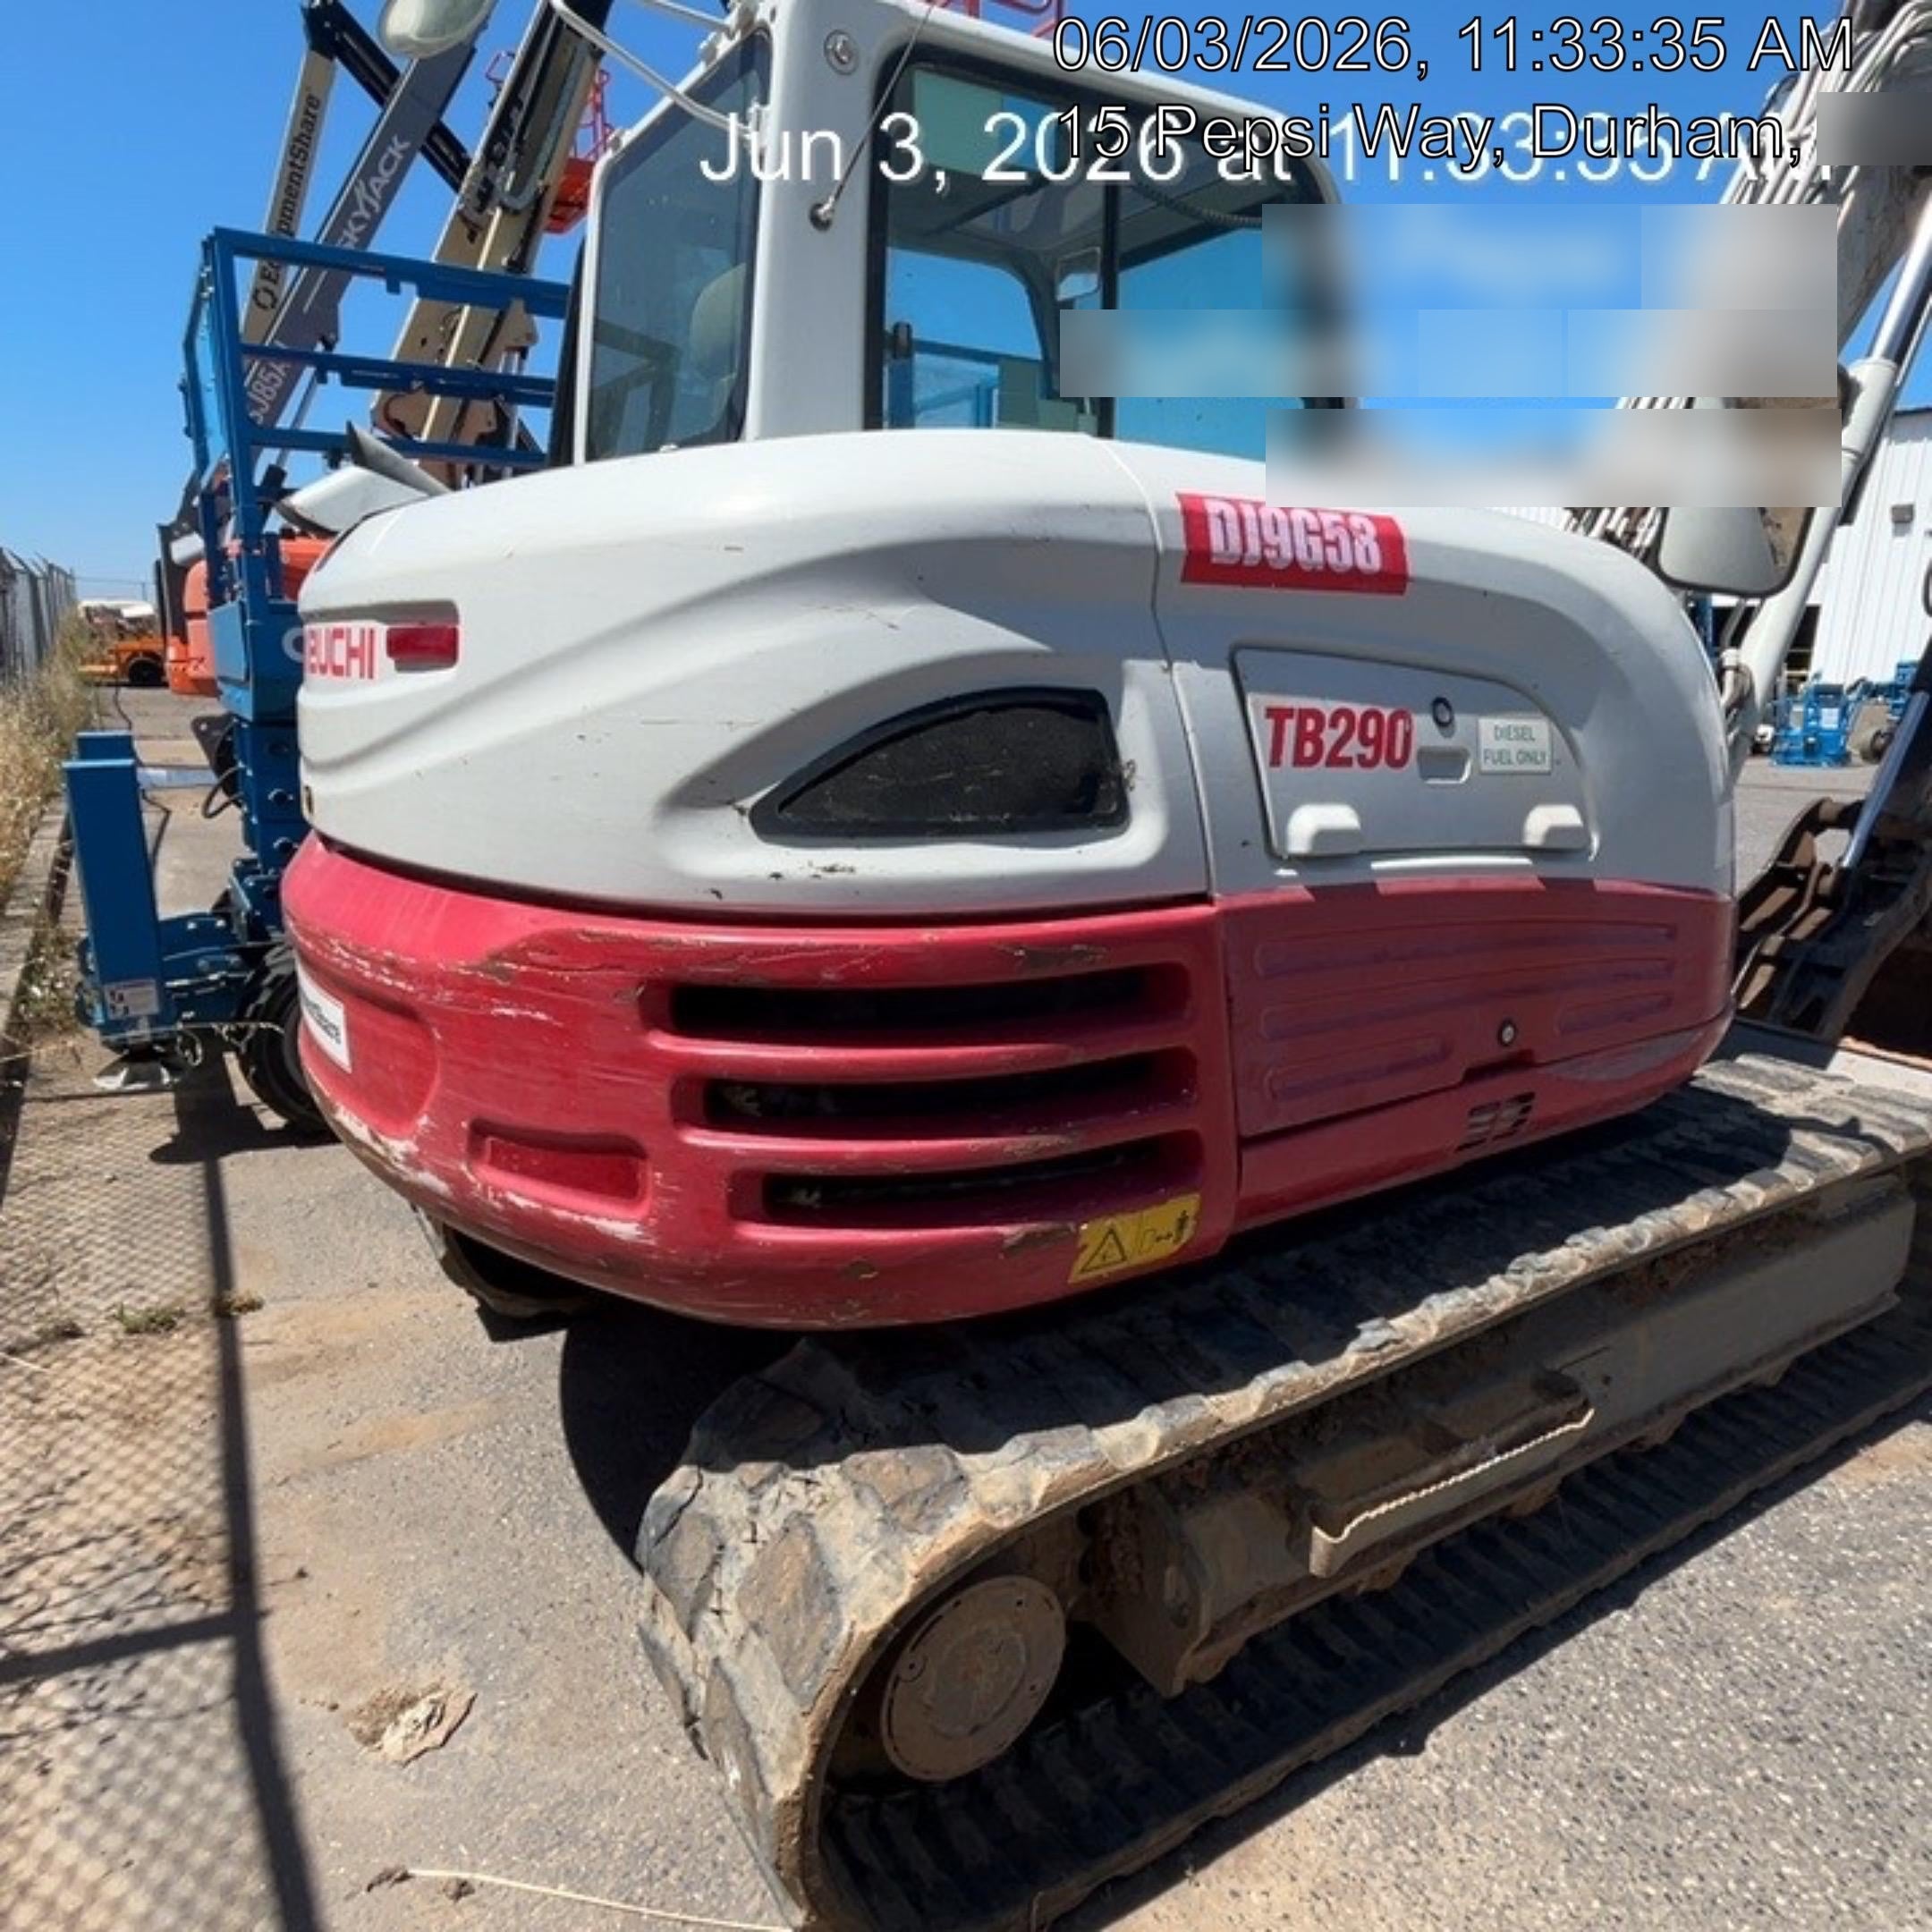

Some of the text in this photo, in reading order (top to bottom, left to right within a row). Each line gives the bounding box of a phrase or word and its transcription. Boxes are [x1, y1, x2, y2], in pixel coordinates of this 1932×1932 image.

[259, 93, 321, 285] EpmentShare
[1264, 707, 1415, 770] TB290
[1494, 723, 1537, 741] DIESEL
[1483, 747, 1547, 767] FUEL ONLY
